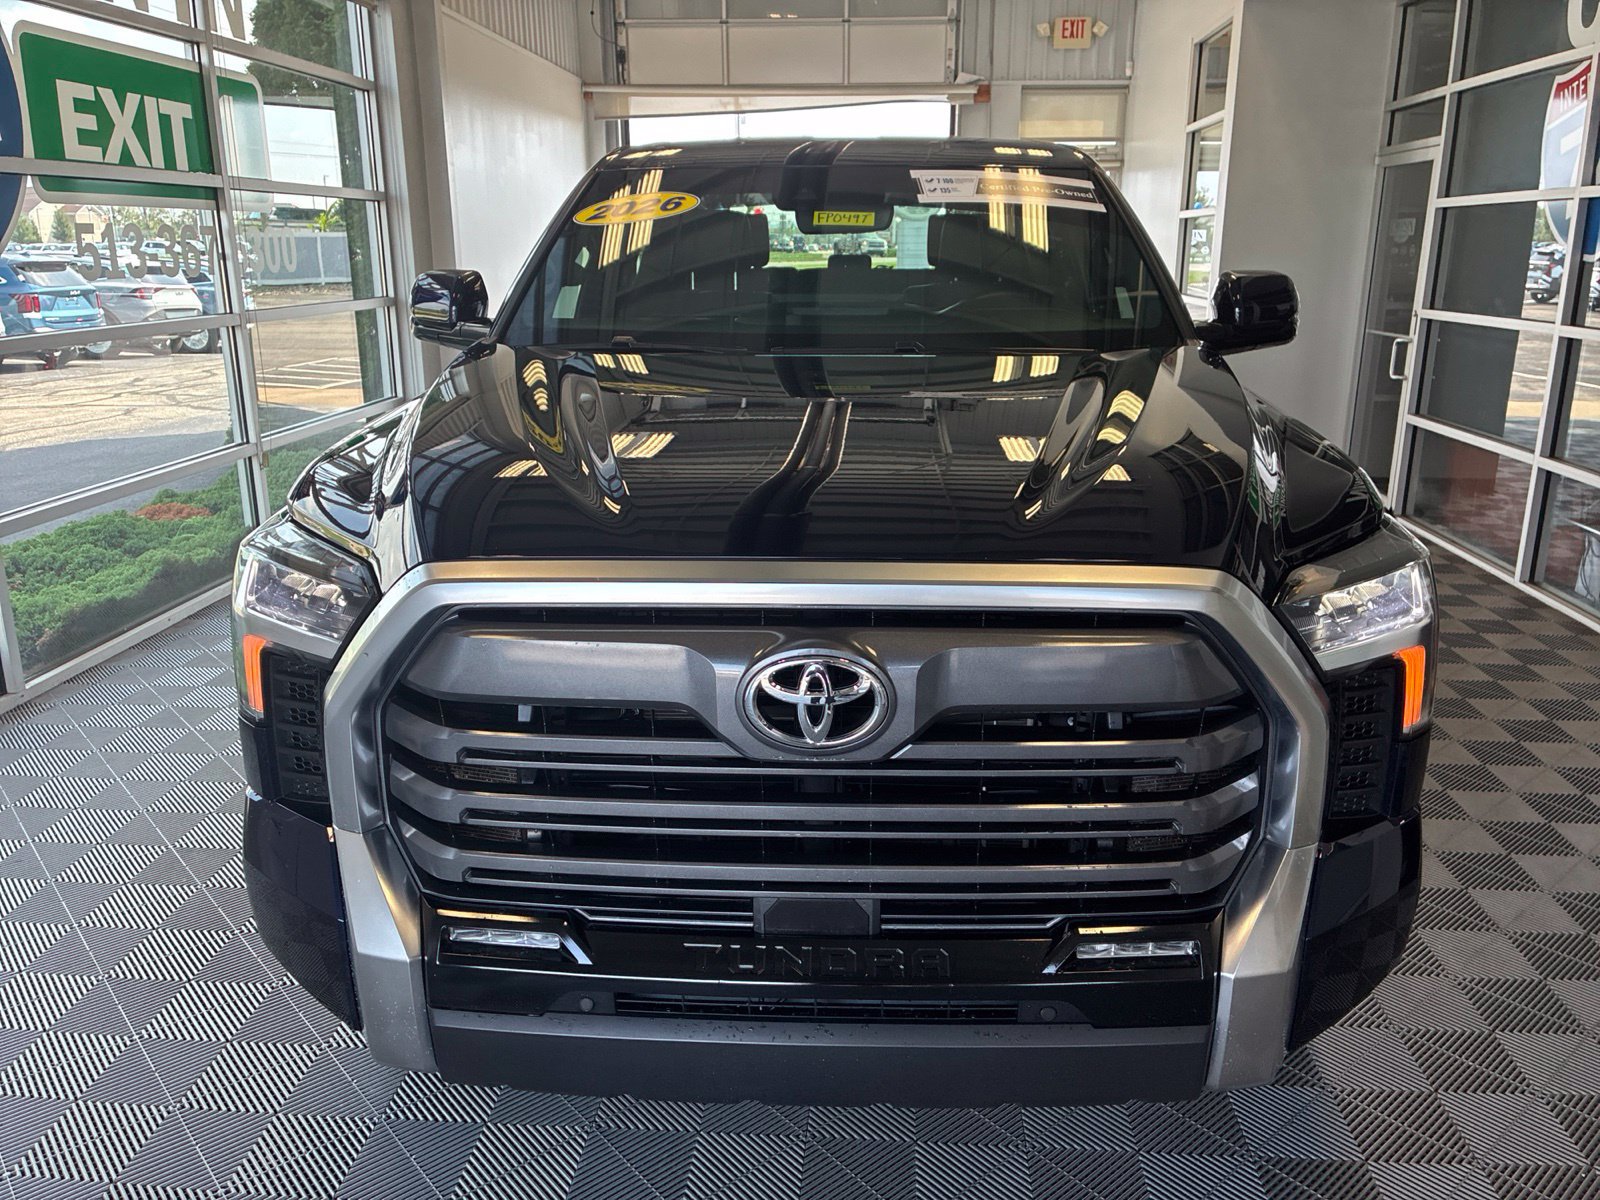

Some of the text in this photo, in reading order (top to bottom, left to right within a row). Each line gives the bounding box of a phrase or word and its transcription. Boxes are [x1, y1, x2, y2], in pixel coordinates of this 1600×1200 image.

[1061, 19, 1086, 39] EXIT
[1560, 74, 1591, 113] INTE
[56, 79, 193, 172] EXIT
[1032, 185, 1093, 199] Pre-Owned
[585, 196, 686, 221] 2026
[683, 943, 950, 978] TUNDRA
